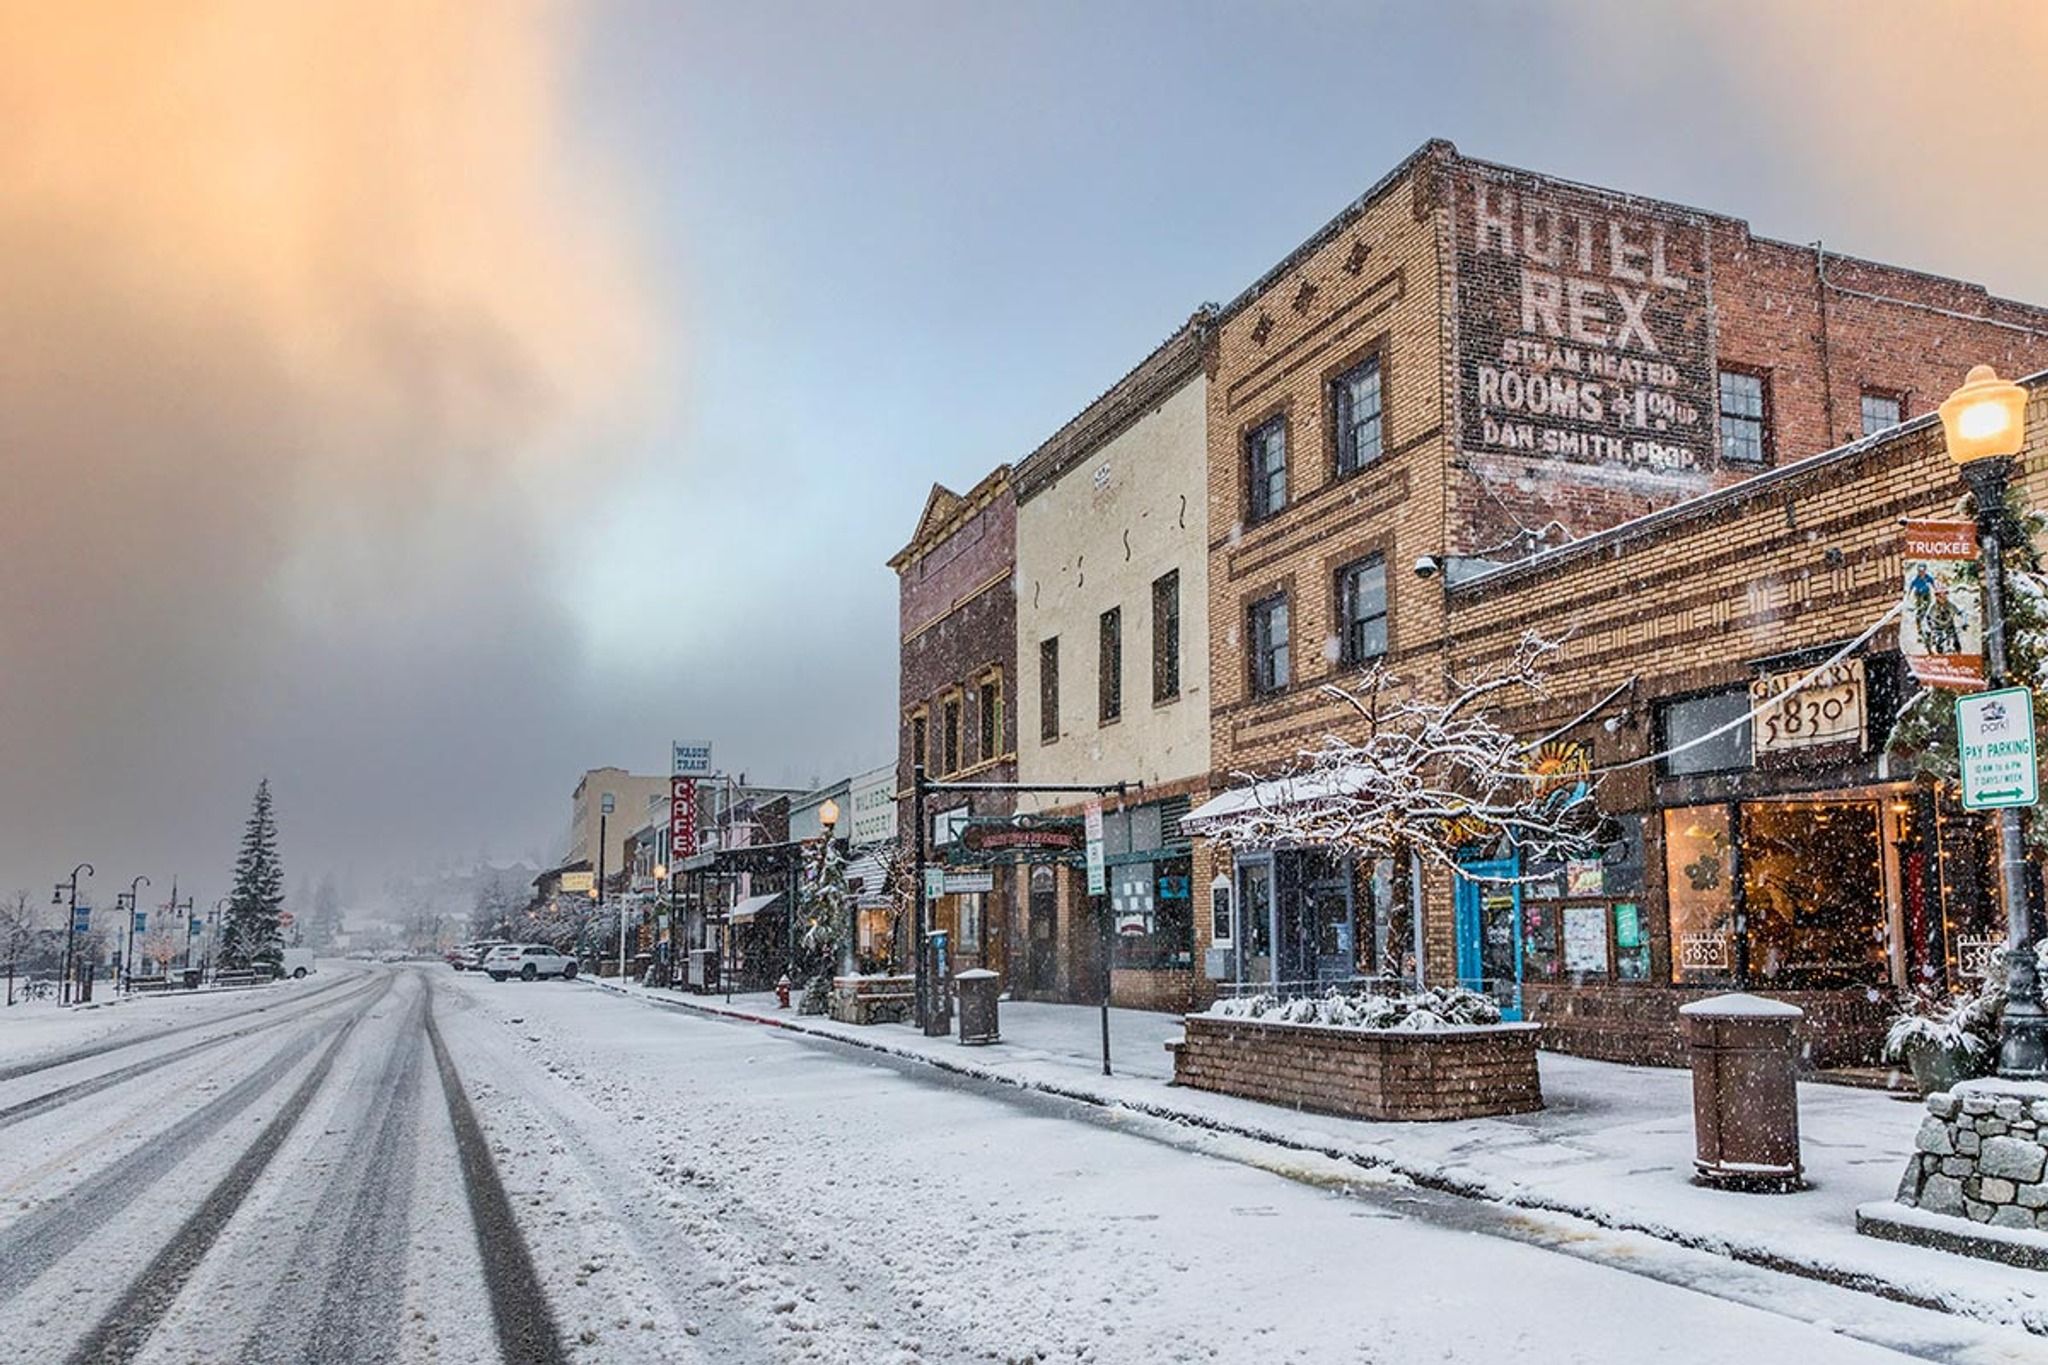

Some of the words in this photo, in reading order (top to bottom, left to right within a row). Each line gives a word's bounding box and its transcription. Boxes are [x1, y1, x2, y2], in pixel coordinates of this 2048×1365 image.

[1474, 184, 1690, 292] HOTEL
[1520, 267, 1660, 353] REX
[1502, 337, 1582, 373] STEAM
[1589, 351, 1679, 387] HEATED
[1478, 365, 1603, 422] ROOMS
[1676, 404, 1698, 426] UP
[1483, 415, 1535, 449] DAN
[1907, 541, 1971, 554] TRUCKEE
[1965, 745, 1983, 760] PAY
[1987, 738, 2030, 758] PARKING
[674, 782, 689, 852] CAFE
